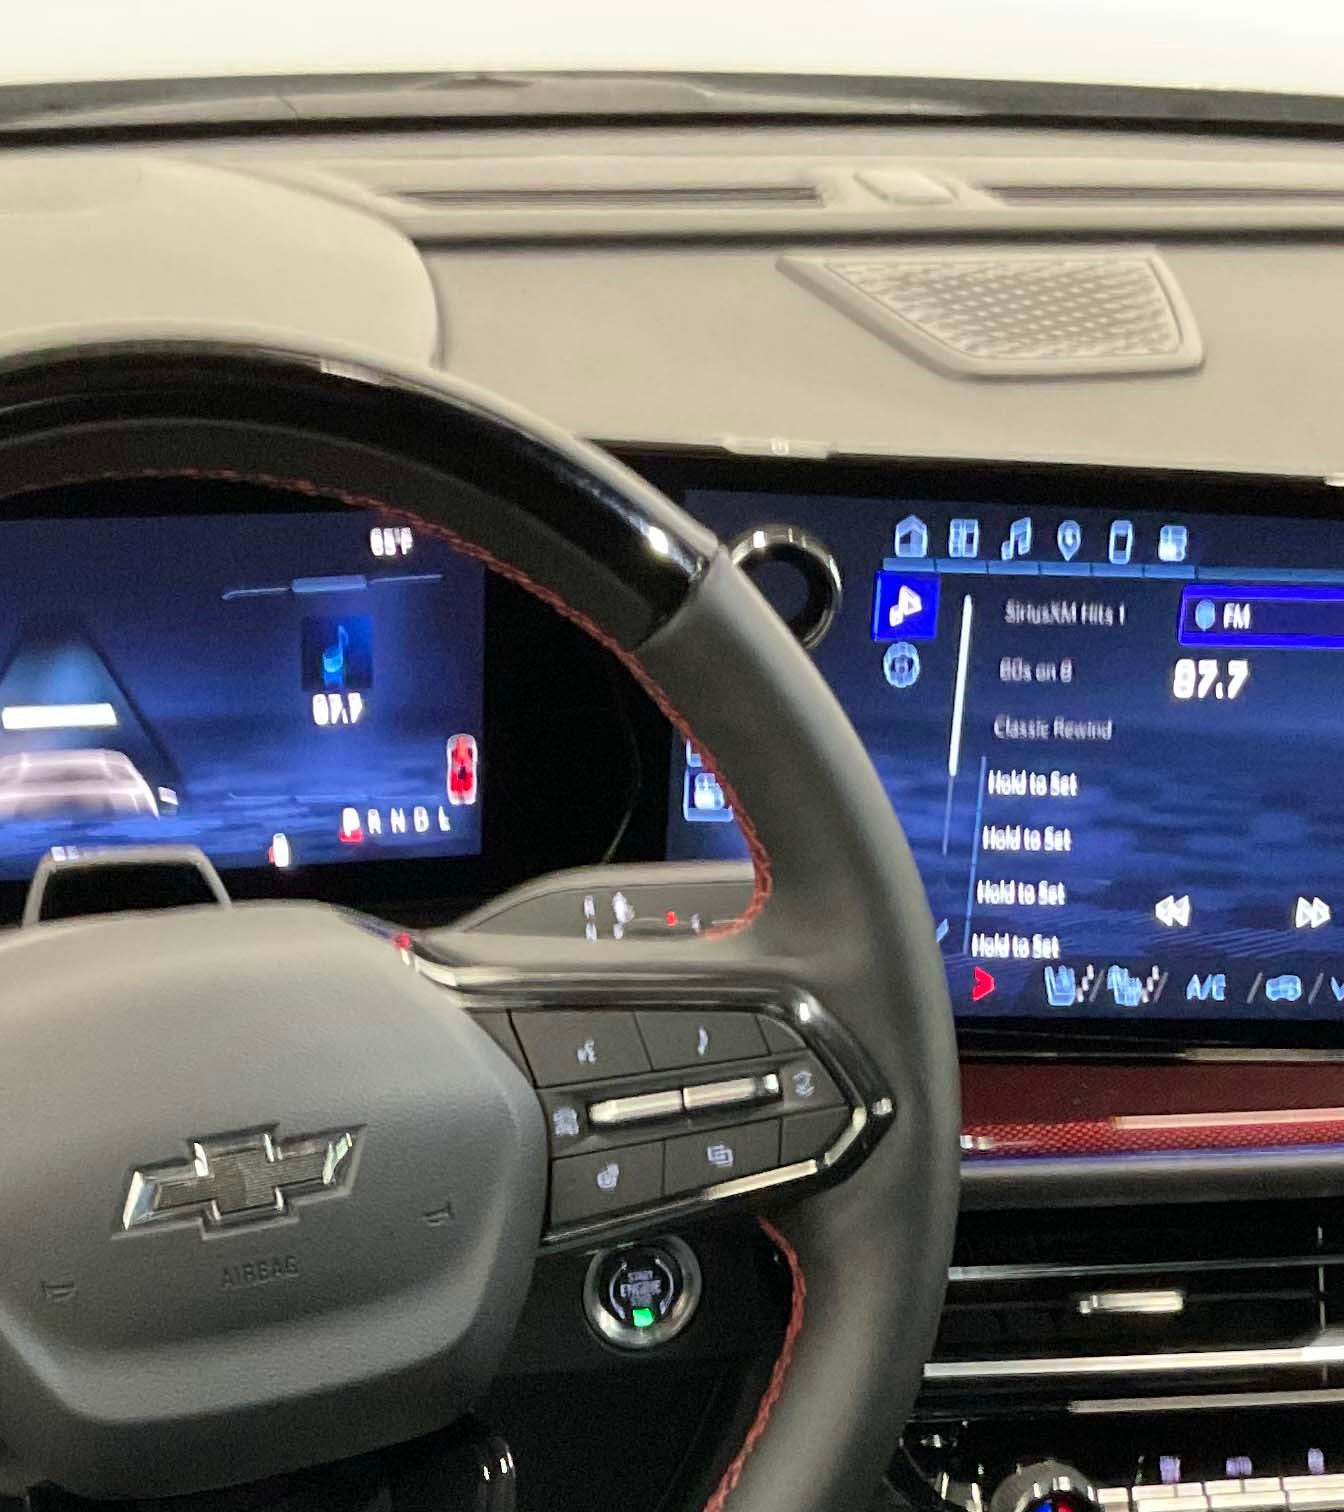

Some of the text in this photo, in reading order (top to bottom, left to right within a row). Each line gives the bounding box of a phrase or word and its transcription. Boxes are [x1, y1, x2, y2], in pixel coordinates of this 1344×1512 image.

[1005, 600, 1077, 625] SiriusXM
[1223, 603, 1251, 629] FM
[1173, 658, 1249, 700] 87.7
[994, 715, 1113, 741] Classic Rewind
[988, 769, 1078, 796] Hold to Set
[982, 825, 1072, 851] Hold to Set
[977, 880, 1065, 905] Hold to Set
[971, 933, 1060, 959] Hold to Set
[222, 1254, 299, 1288] AIRBAG
